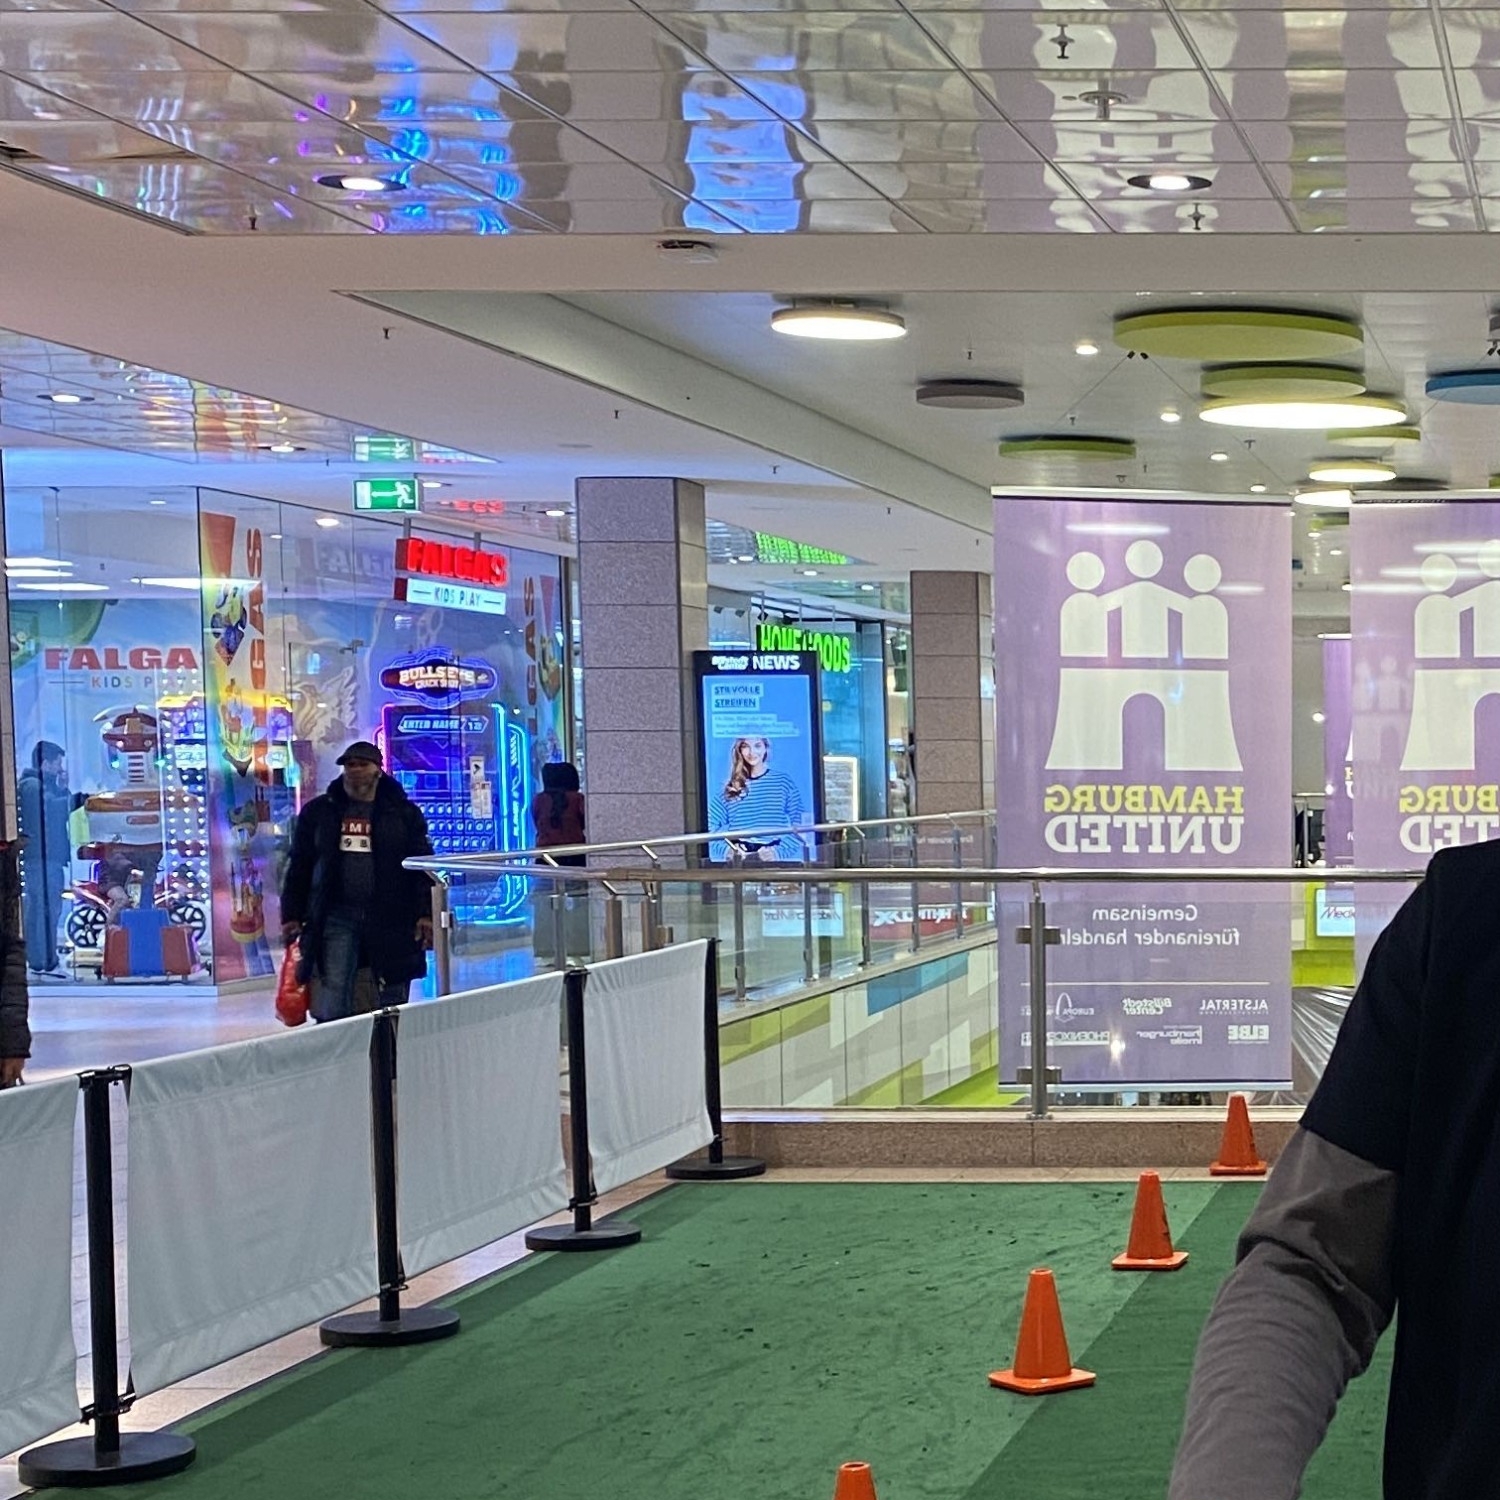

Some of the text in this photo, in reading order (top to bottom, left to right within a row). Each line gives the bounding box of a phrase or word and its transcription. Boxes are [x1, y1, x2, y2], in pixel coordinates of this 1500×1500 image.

[407, 537, 507, 587] FALGAS
[435, 587, 481, 607] KIDS PLAY
[44, 647, 198, 671] FALGA
[753, 655, 800, 671] NEWS
[92, 676, 133, 689] KIDS
[714, 686, 760, 695] STILVOLLE
[714, 699, 756, 708] STREIFEN
